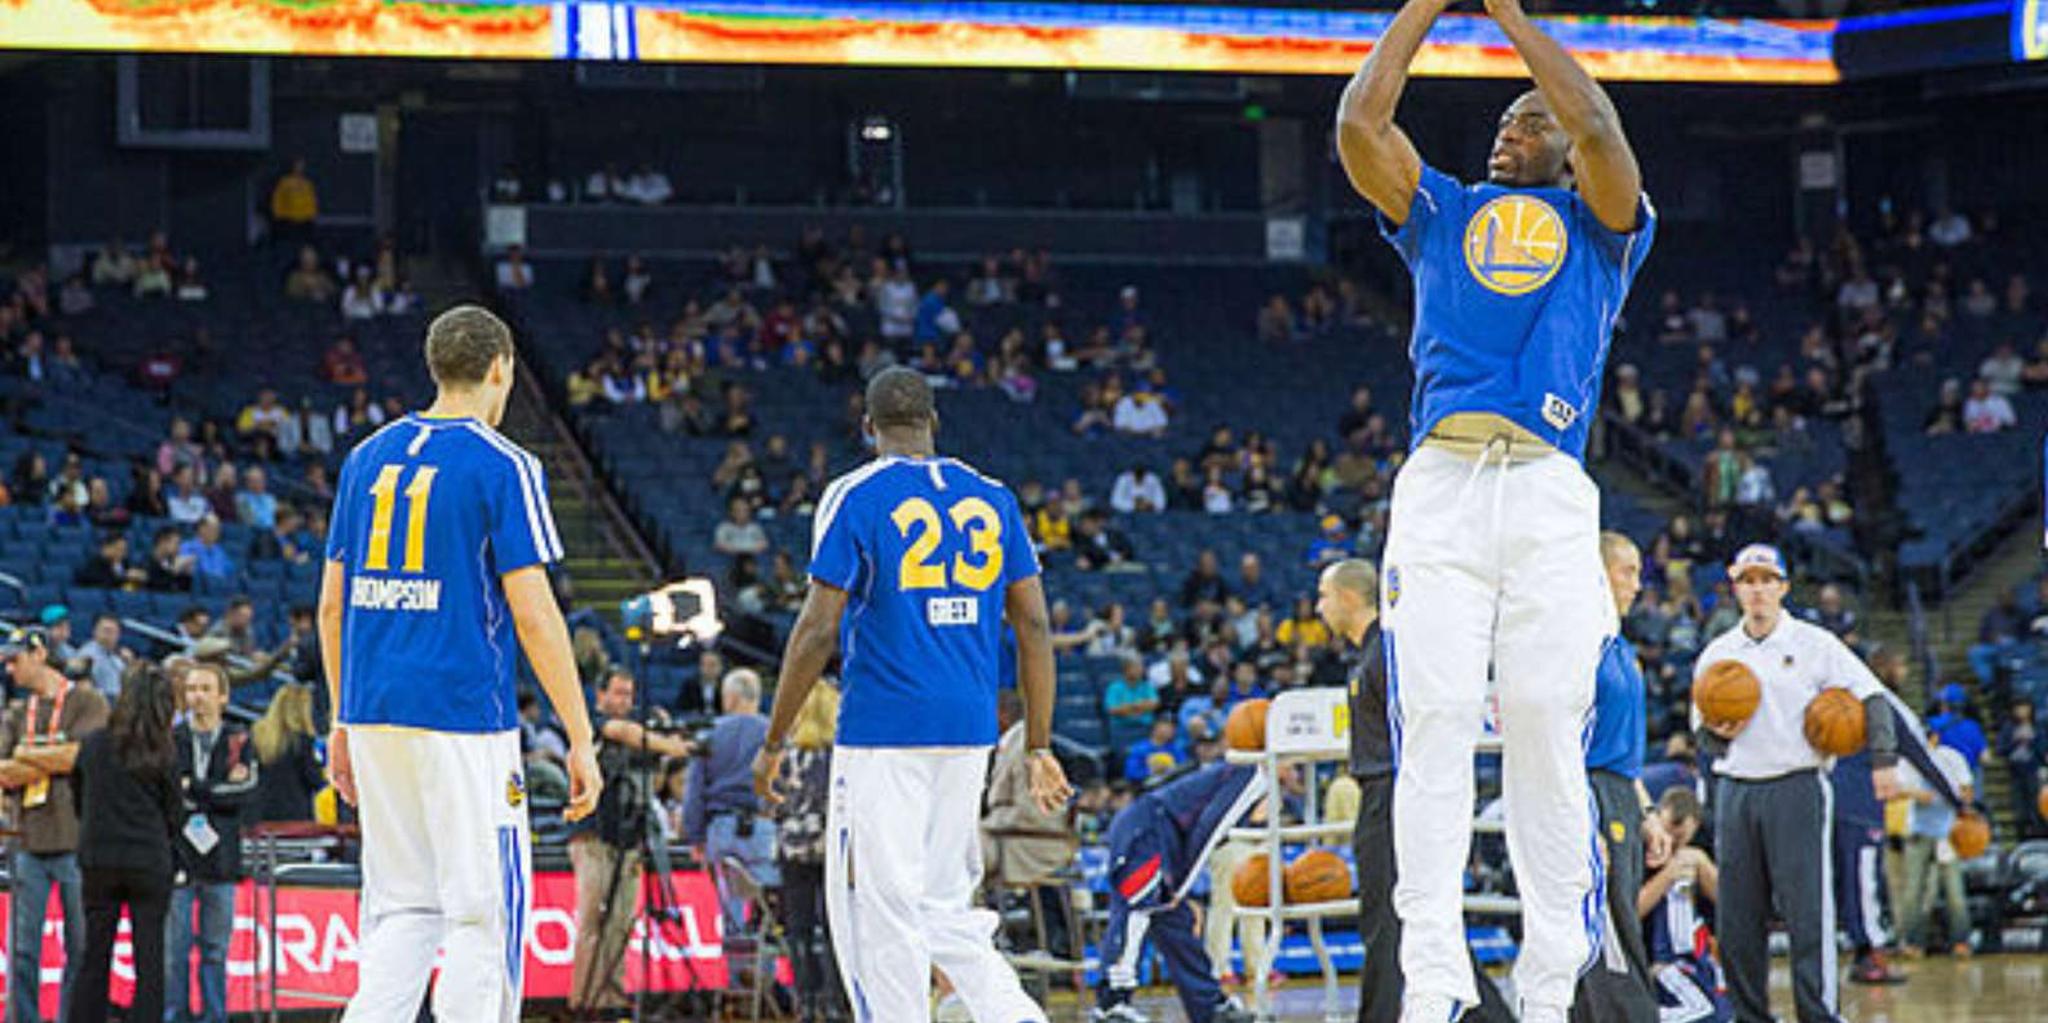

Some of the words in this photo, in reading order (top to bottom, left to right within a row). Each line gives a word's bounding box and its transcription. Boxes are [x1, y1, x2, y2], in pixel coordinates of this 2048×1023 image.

[364, 463, 440, 574] 11
[890, 496, 1004, 591] 23
[351, 576, 441, 610] HOMPSON
